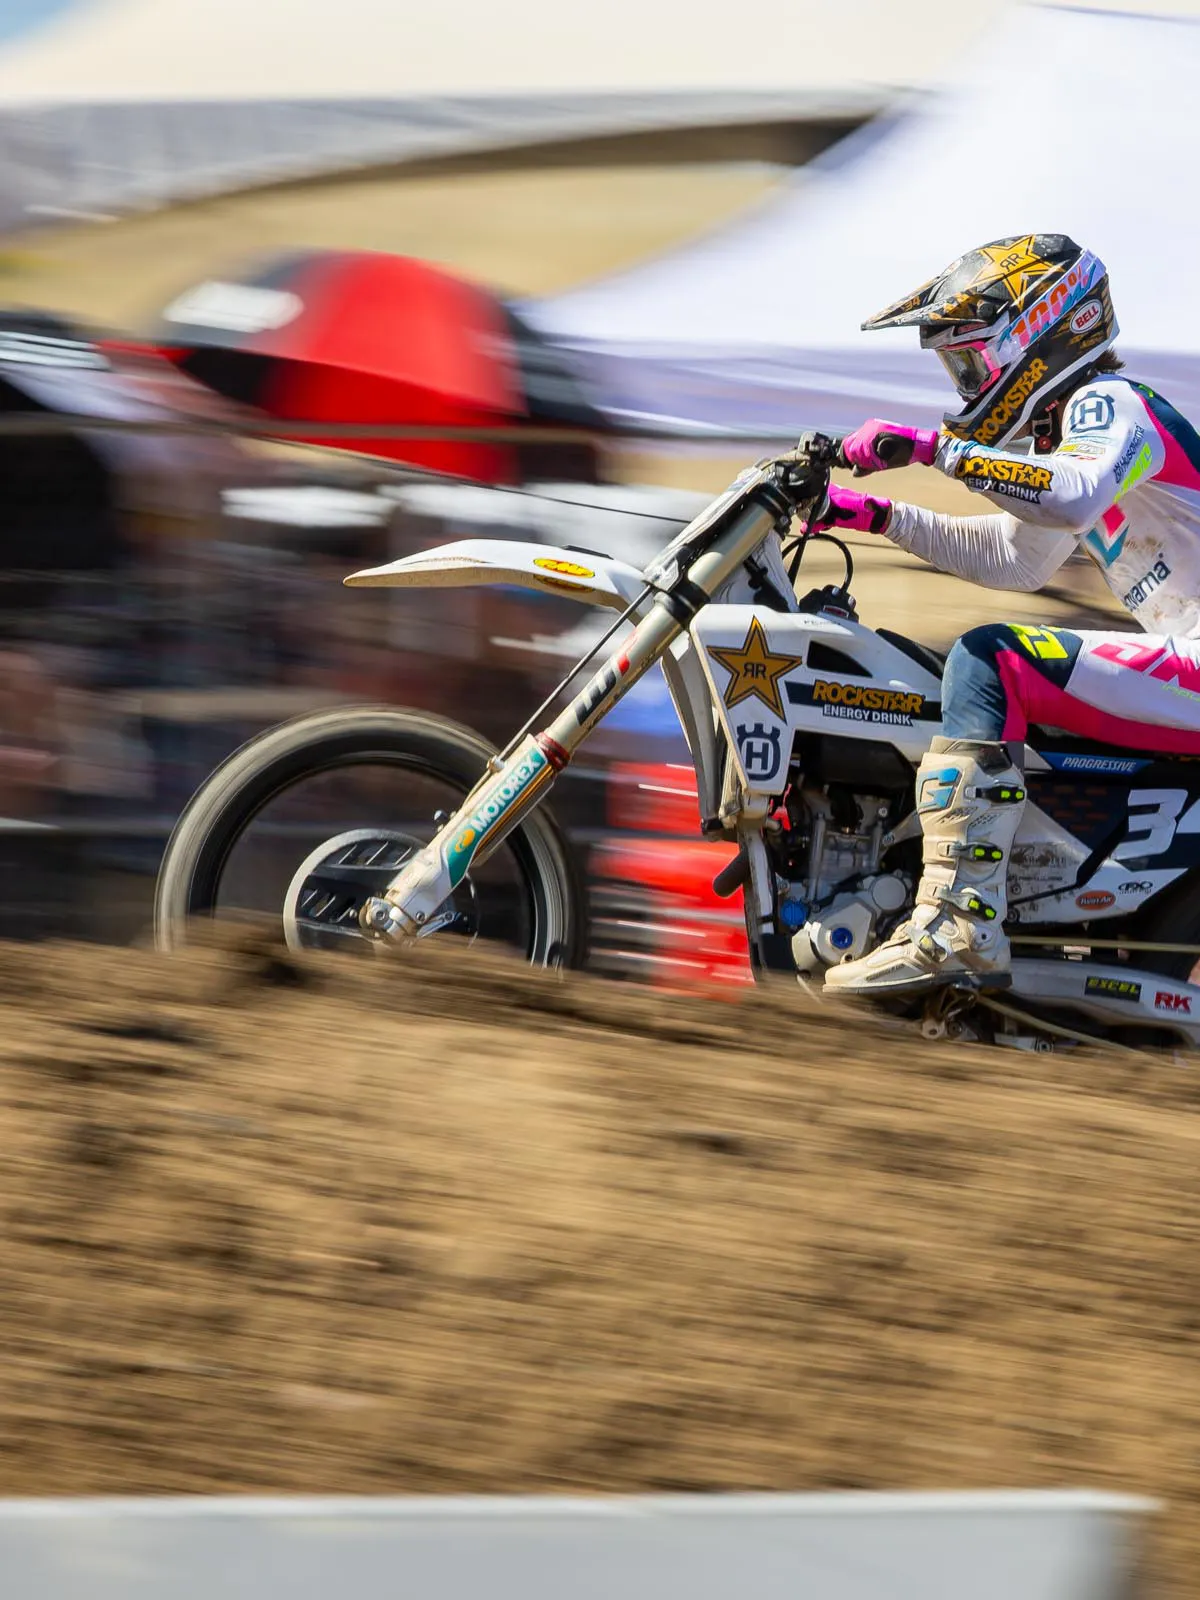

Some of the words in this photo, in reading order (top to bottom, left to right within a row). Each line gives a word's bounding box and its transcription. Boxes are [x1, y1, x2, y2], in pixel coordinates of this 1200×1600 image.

[1010, 264, 1090, 347] 100%
[1074, 304, 1100, 329] BELL
[973, 357, 1049, 443] ROCKSTAR
[956, 456, 1052, 489] OCKSTAR
[998, 483, 1039, 503] DRINK
[812, 680, 923, 714] ROCKSTAR
[823, 704, 870, 721] ENERGY
[872, 711, 911, 725] DRINK
[1062, 756, 1137, 772] PROGRESSIVE
[470, 754, 540, 832] MOTOREX
[1154, 991, 1193, 1012] RK
